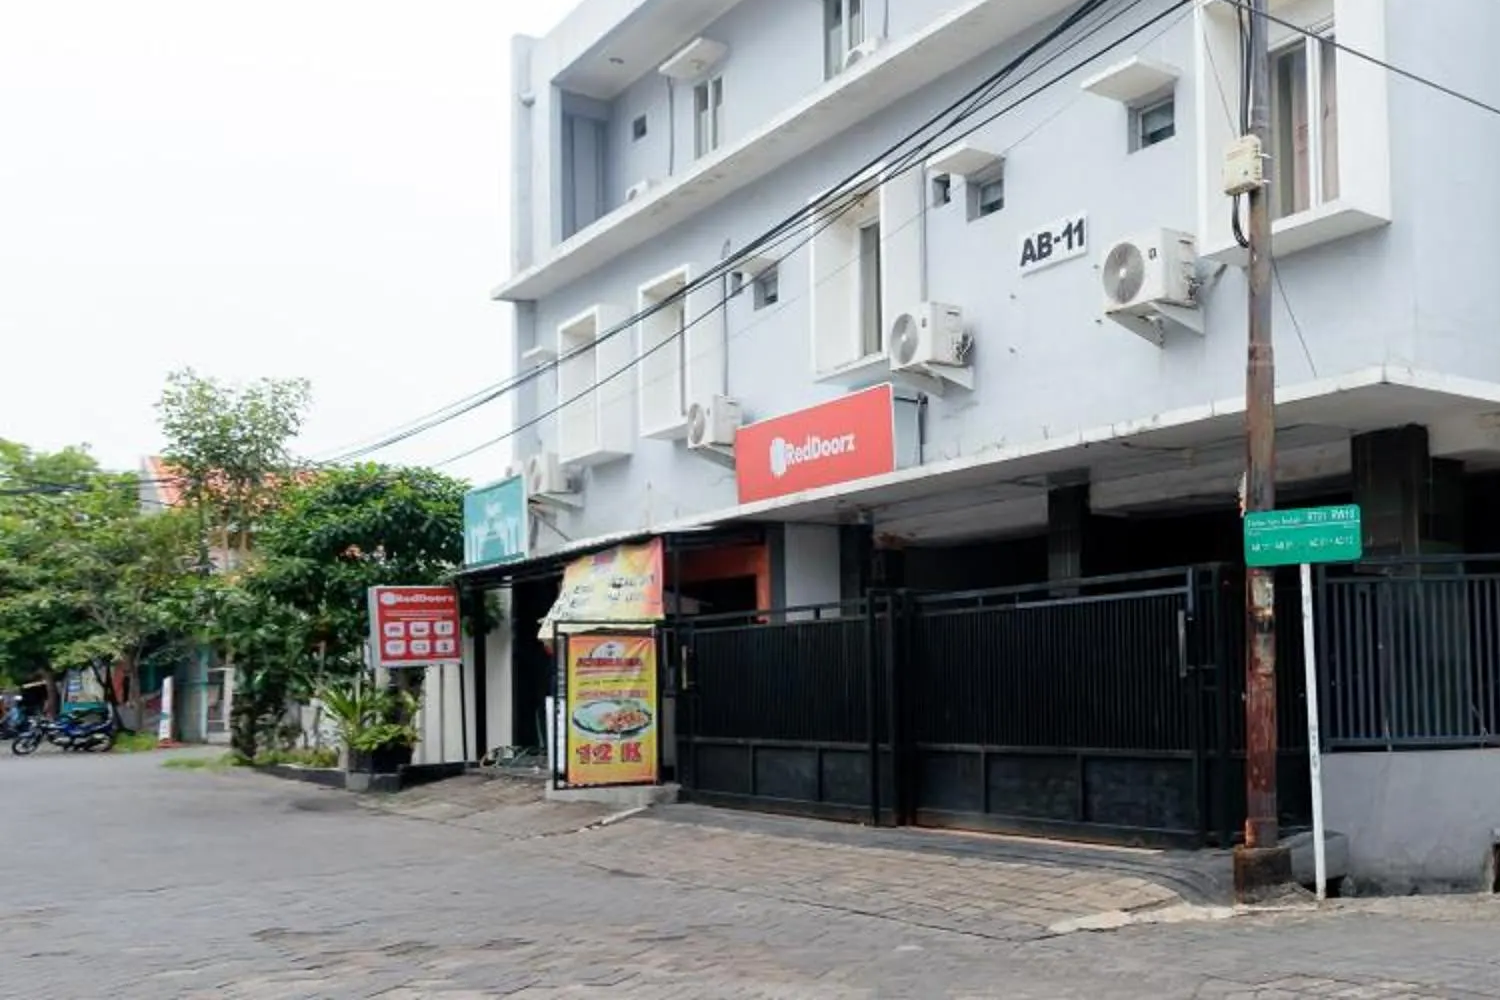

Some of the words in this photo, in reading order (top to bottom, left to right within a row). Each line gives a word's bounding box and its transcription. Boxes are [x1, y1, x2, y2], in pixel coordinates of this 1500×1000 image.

[1020, 219, 1085, 267] AB-11
[785, 433, 856, 467] RedDoorz
[576, 743, 613, 765] 12
[621, 742, 642, 763] K
